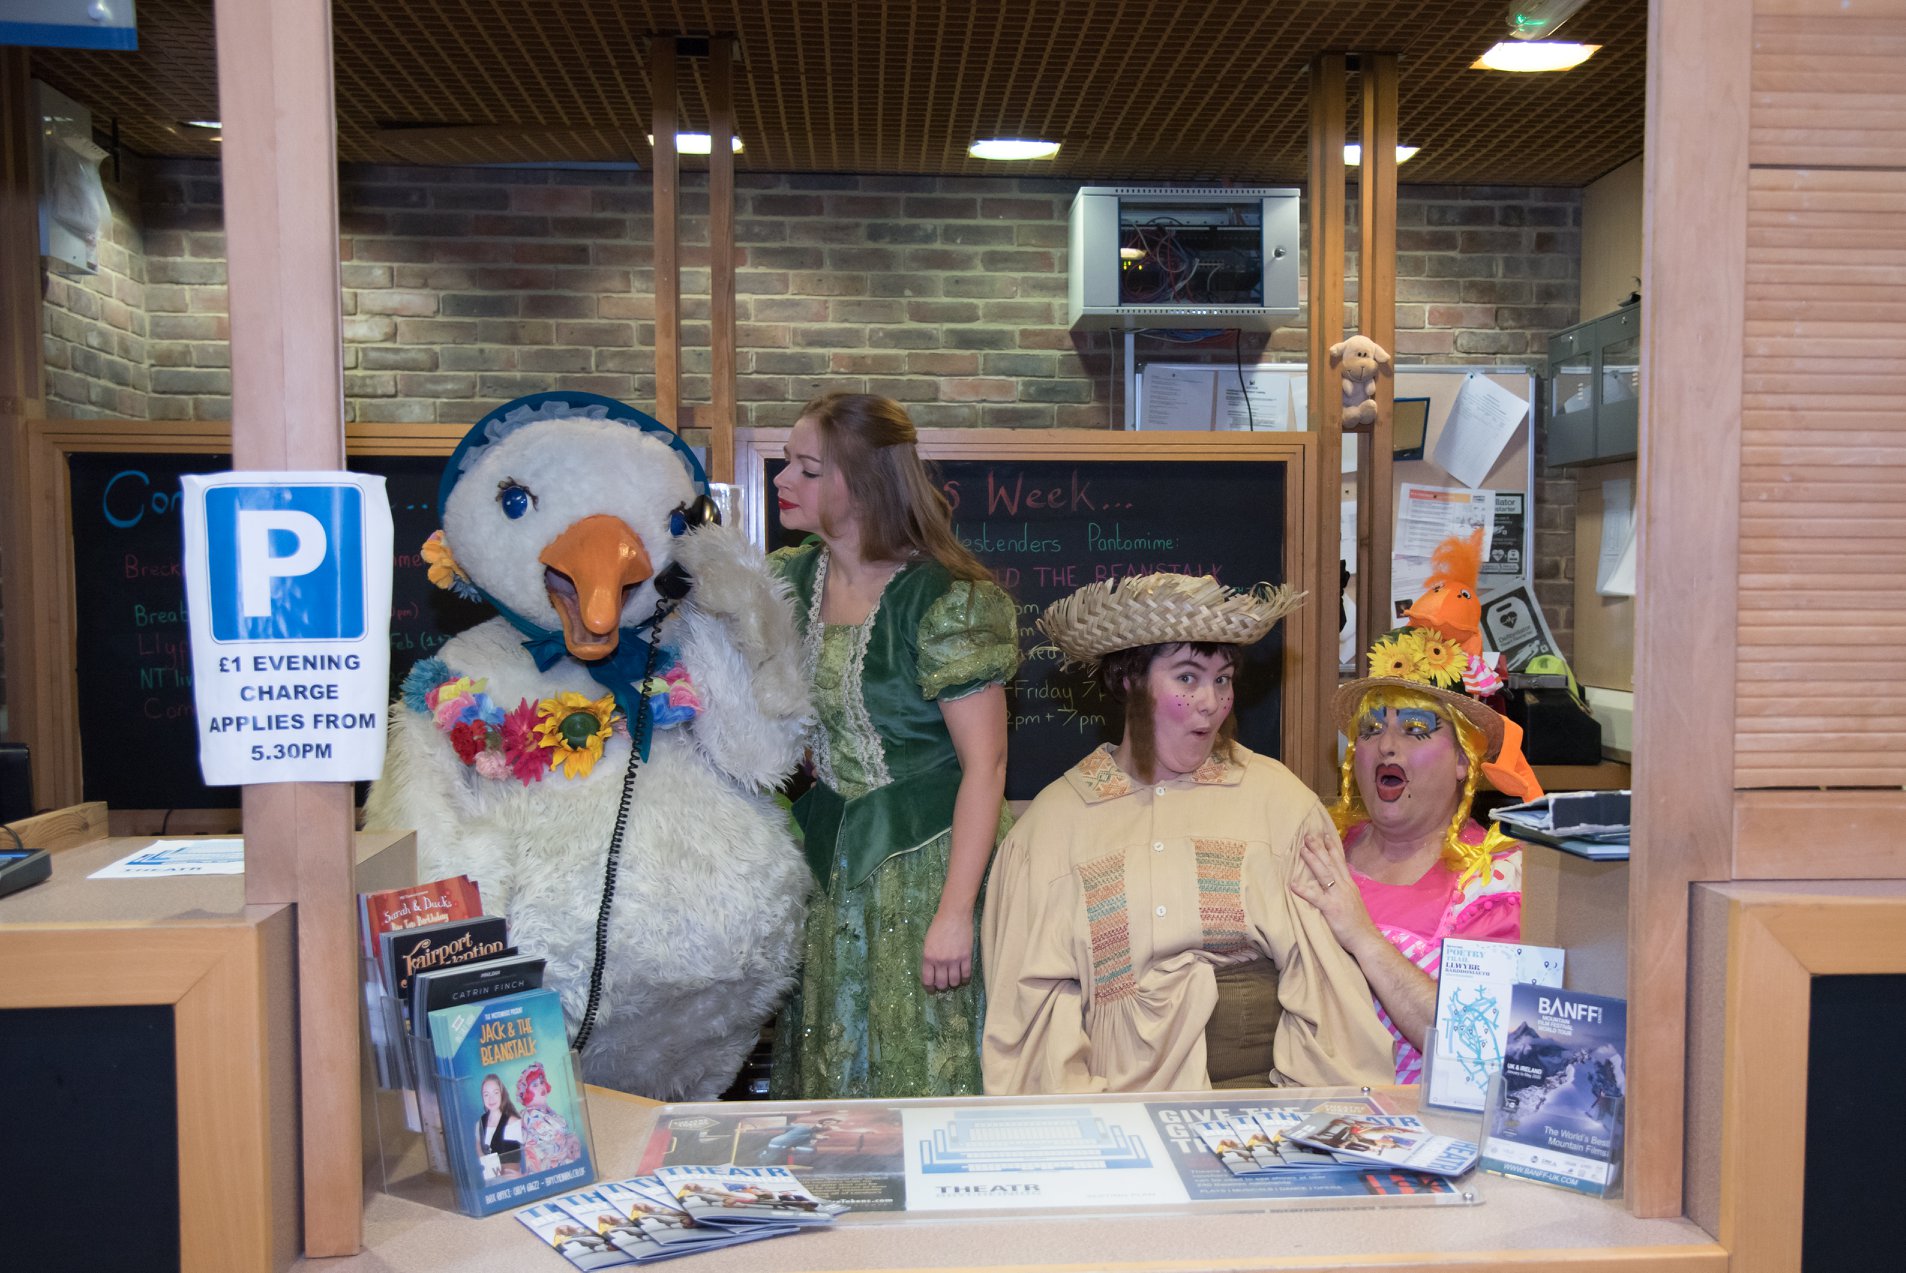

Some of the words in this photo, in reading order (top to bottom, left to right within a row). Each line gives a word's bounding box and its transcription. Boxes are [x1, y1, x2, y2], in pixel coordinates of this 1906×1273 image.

[987, 469, 1133, 516] Week...
[956, 522, 1061, 553] estenders
[239, 510, 327, 617] P
[1033, 565, 1077, 588] THE
[219, 656, 241, 673] £1
[253, 654, 361, 672] EVENING
[240, 684, 340, 701] CHARGE
[209, 714, 305, 733] APPLIES
[313, 713, 377, 730] FROM
[251, 743, 333, 761] 5.30PM
[384, 903, 411, 923] Sarah
[413, 900, 422, 911] &
[402, 931, 473, 976] Fairport
[452, 987, 489, 1001] CATRIN
[494, 980, 525, 992] FINCH
[1538, 997, 1599, 1022] BANFF
[480, 1021, 506, 1044] JACK
[507, 1021, 516, 1038] &
[517, 1017, 533, 1036] THE
[480, 1036, 537, 1067] BEANSTALK
[1520, 1065, 1542, 1075] IRELAND
[1158, 1108, 1230, 1124] GIVE
[1544, 1126, 1559, 1137] The
[1548, 1136, 1584, 1152] Mountain
[658, 1166, 793, 1177] THEATR
[935, 1183, 1042, 1194] THEATR
